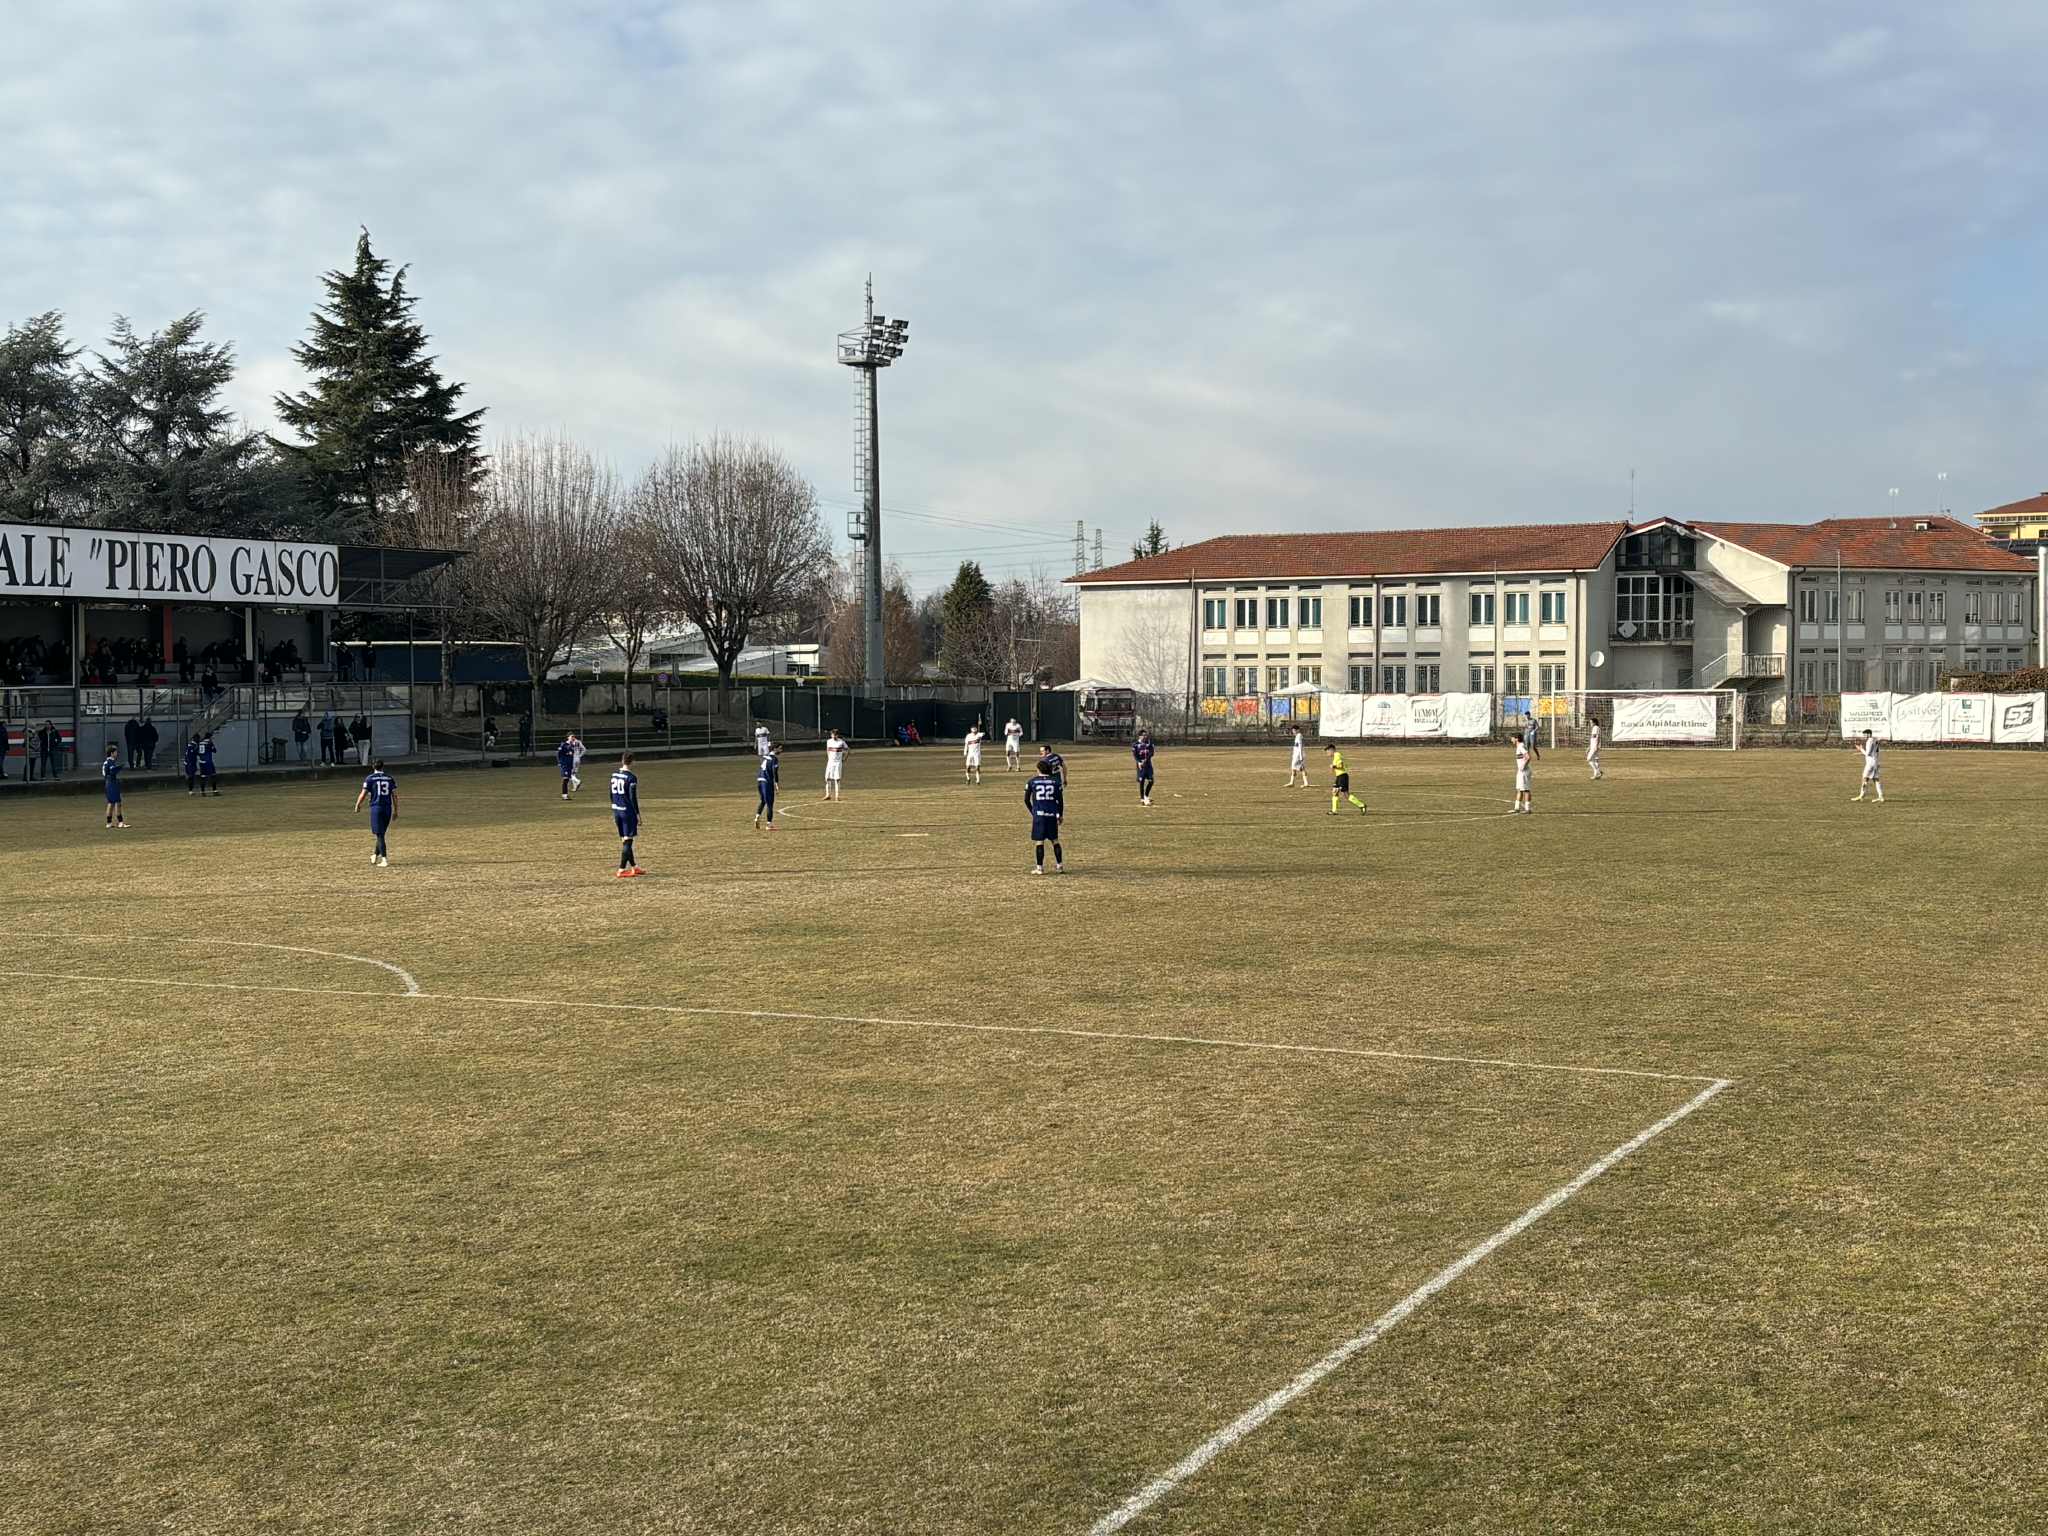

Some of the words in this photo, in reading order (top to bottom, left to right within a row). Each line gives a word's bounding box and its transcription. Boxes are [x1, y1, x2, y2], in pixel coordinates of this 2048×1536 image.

[230, 546, 339, 598] GASCO
[376, 780, 389, 796] 13
[610, 777, 625, 795] 20
[1035, 785, 1055, 801] 22
